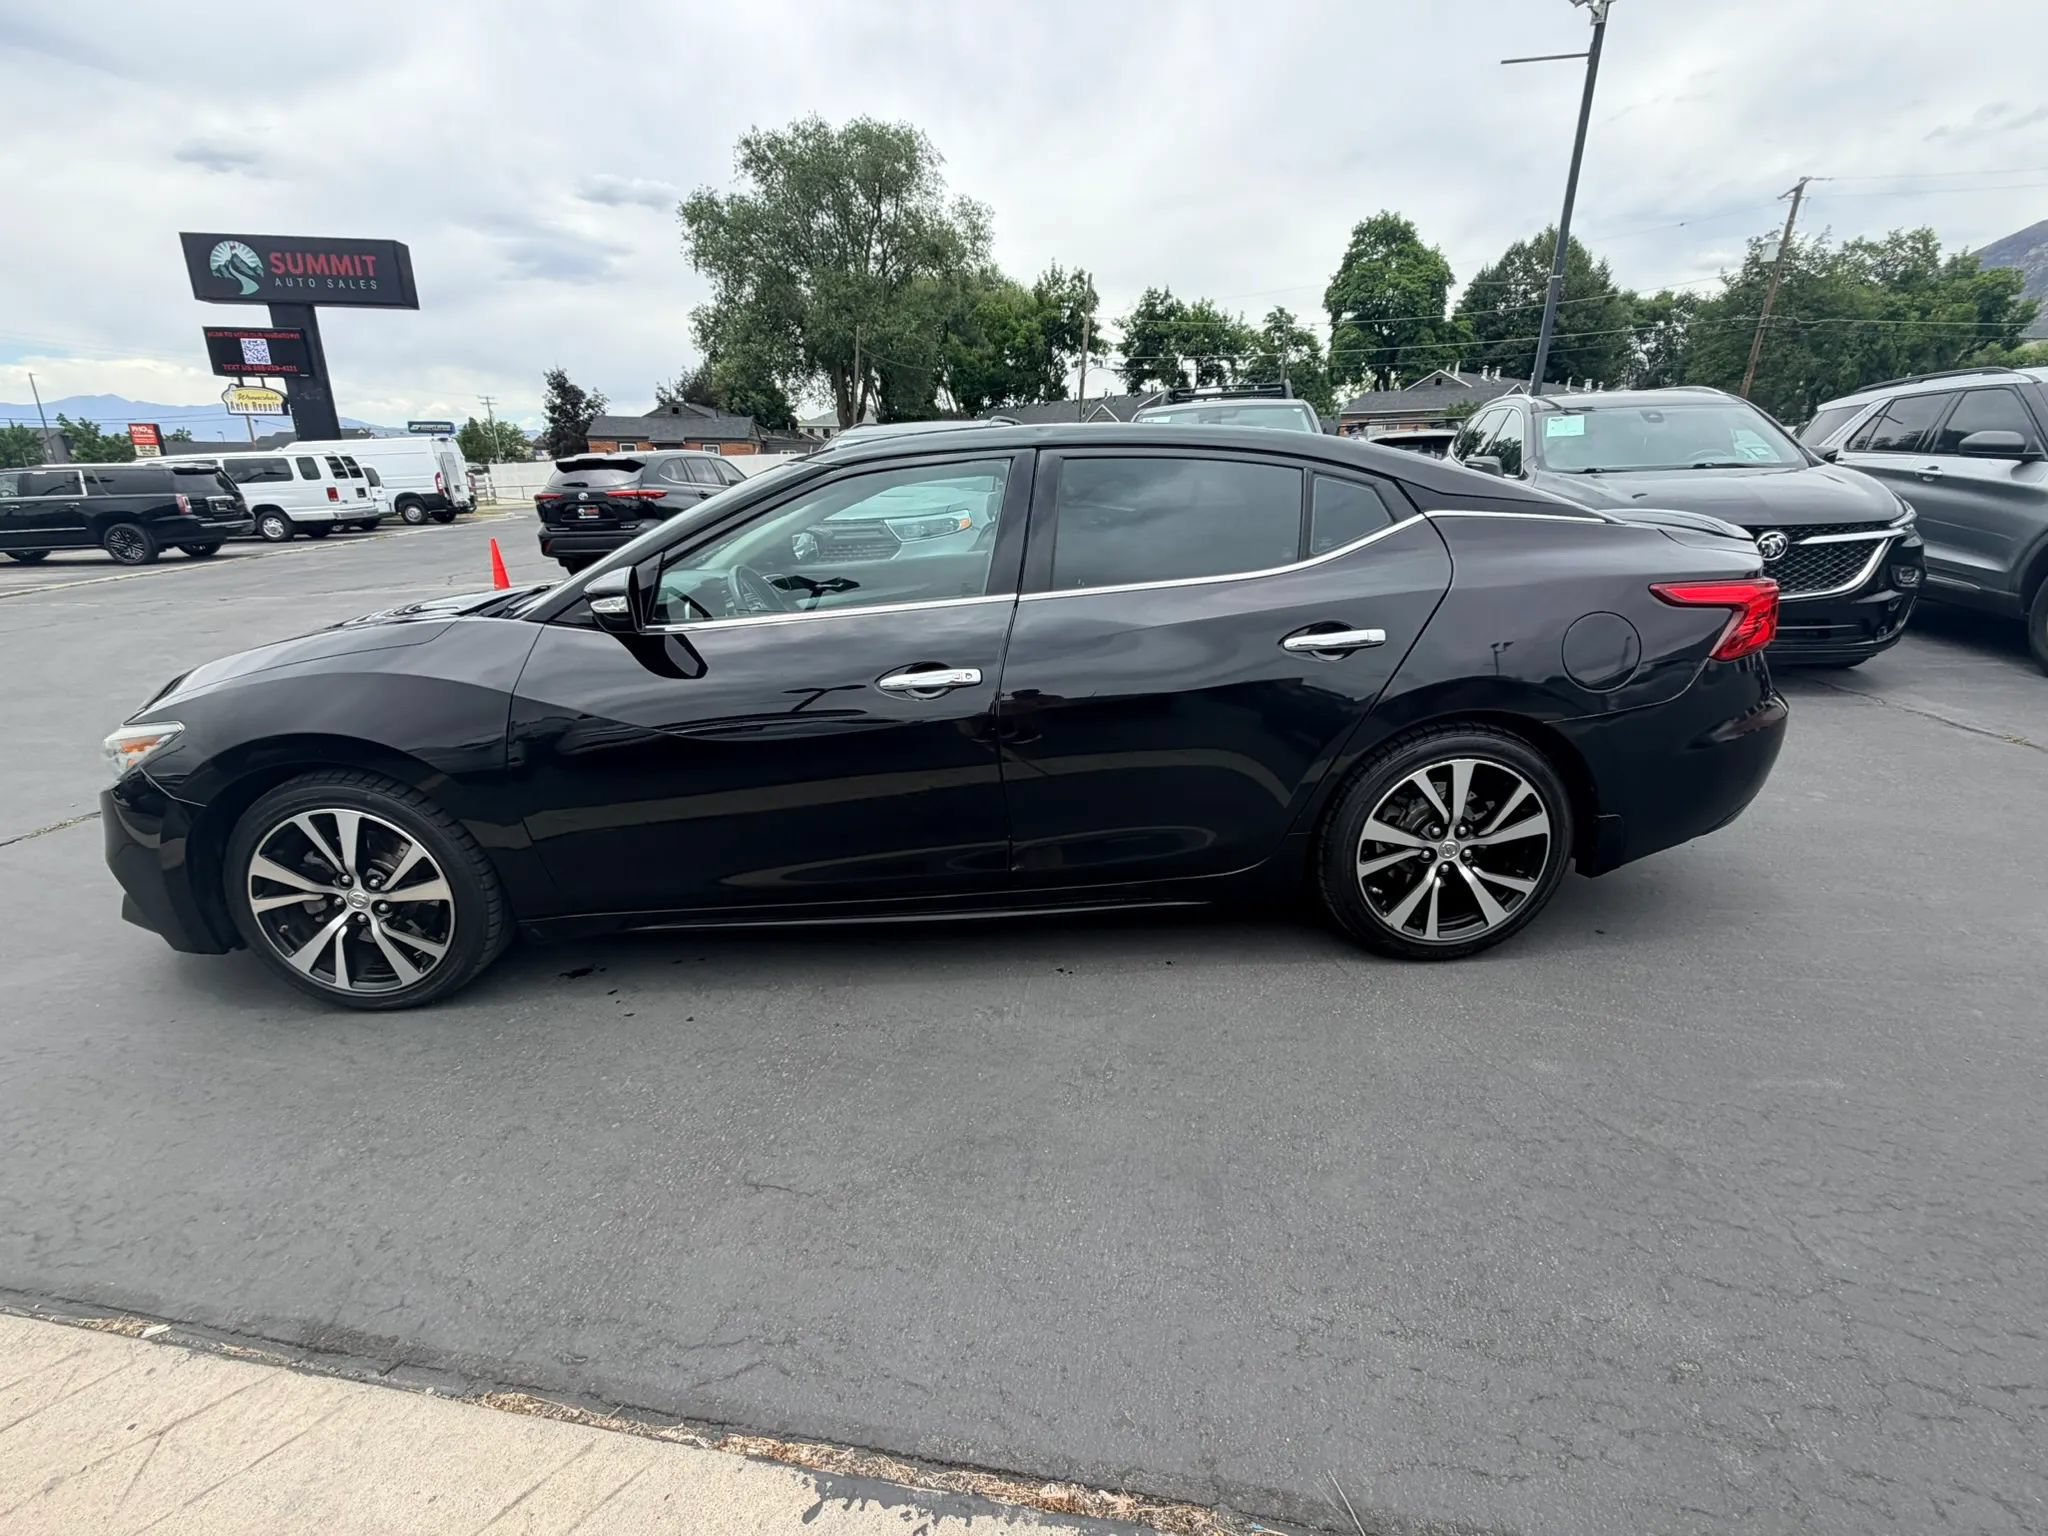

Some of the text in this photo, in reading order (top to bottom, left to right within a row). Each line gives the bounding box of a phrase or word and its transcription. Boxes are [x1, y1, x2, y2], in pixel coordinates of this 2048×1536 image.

[270, 252, 377, 277] SUMMIT
[274, 278, 377, 290] AUTO SALES
[222, 363, 240, 372] TEXT
[230, 401, 280, 412] Auto Repair
